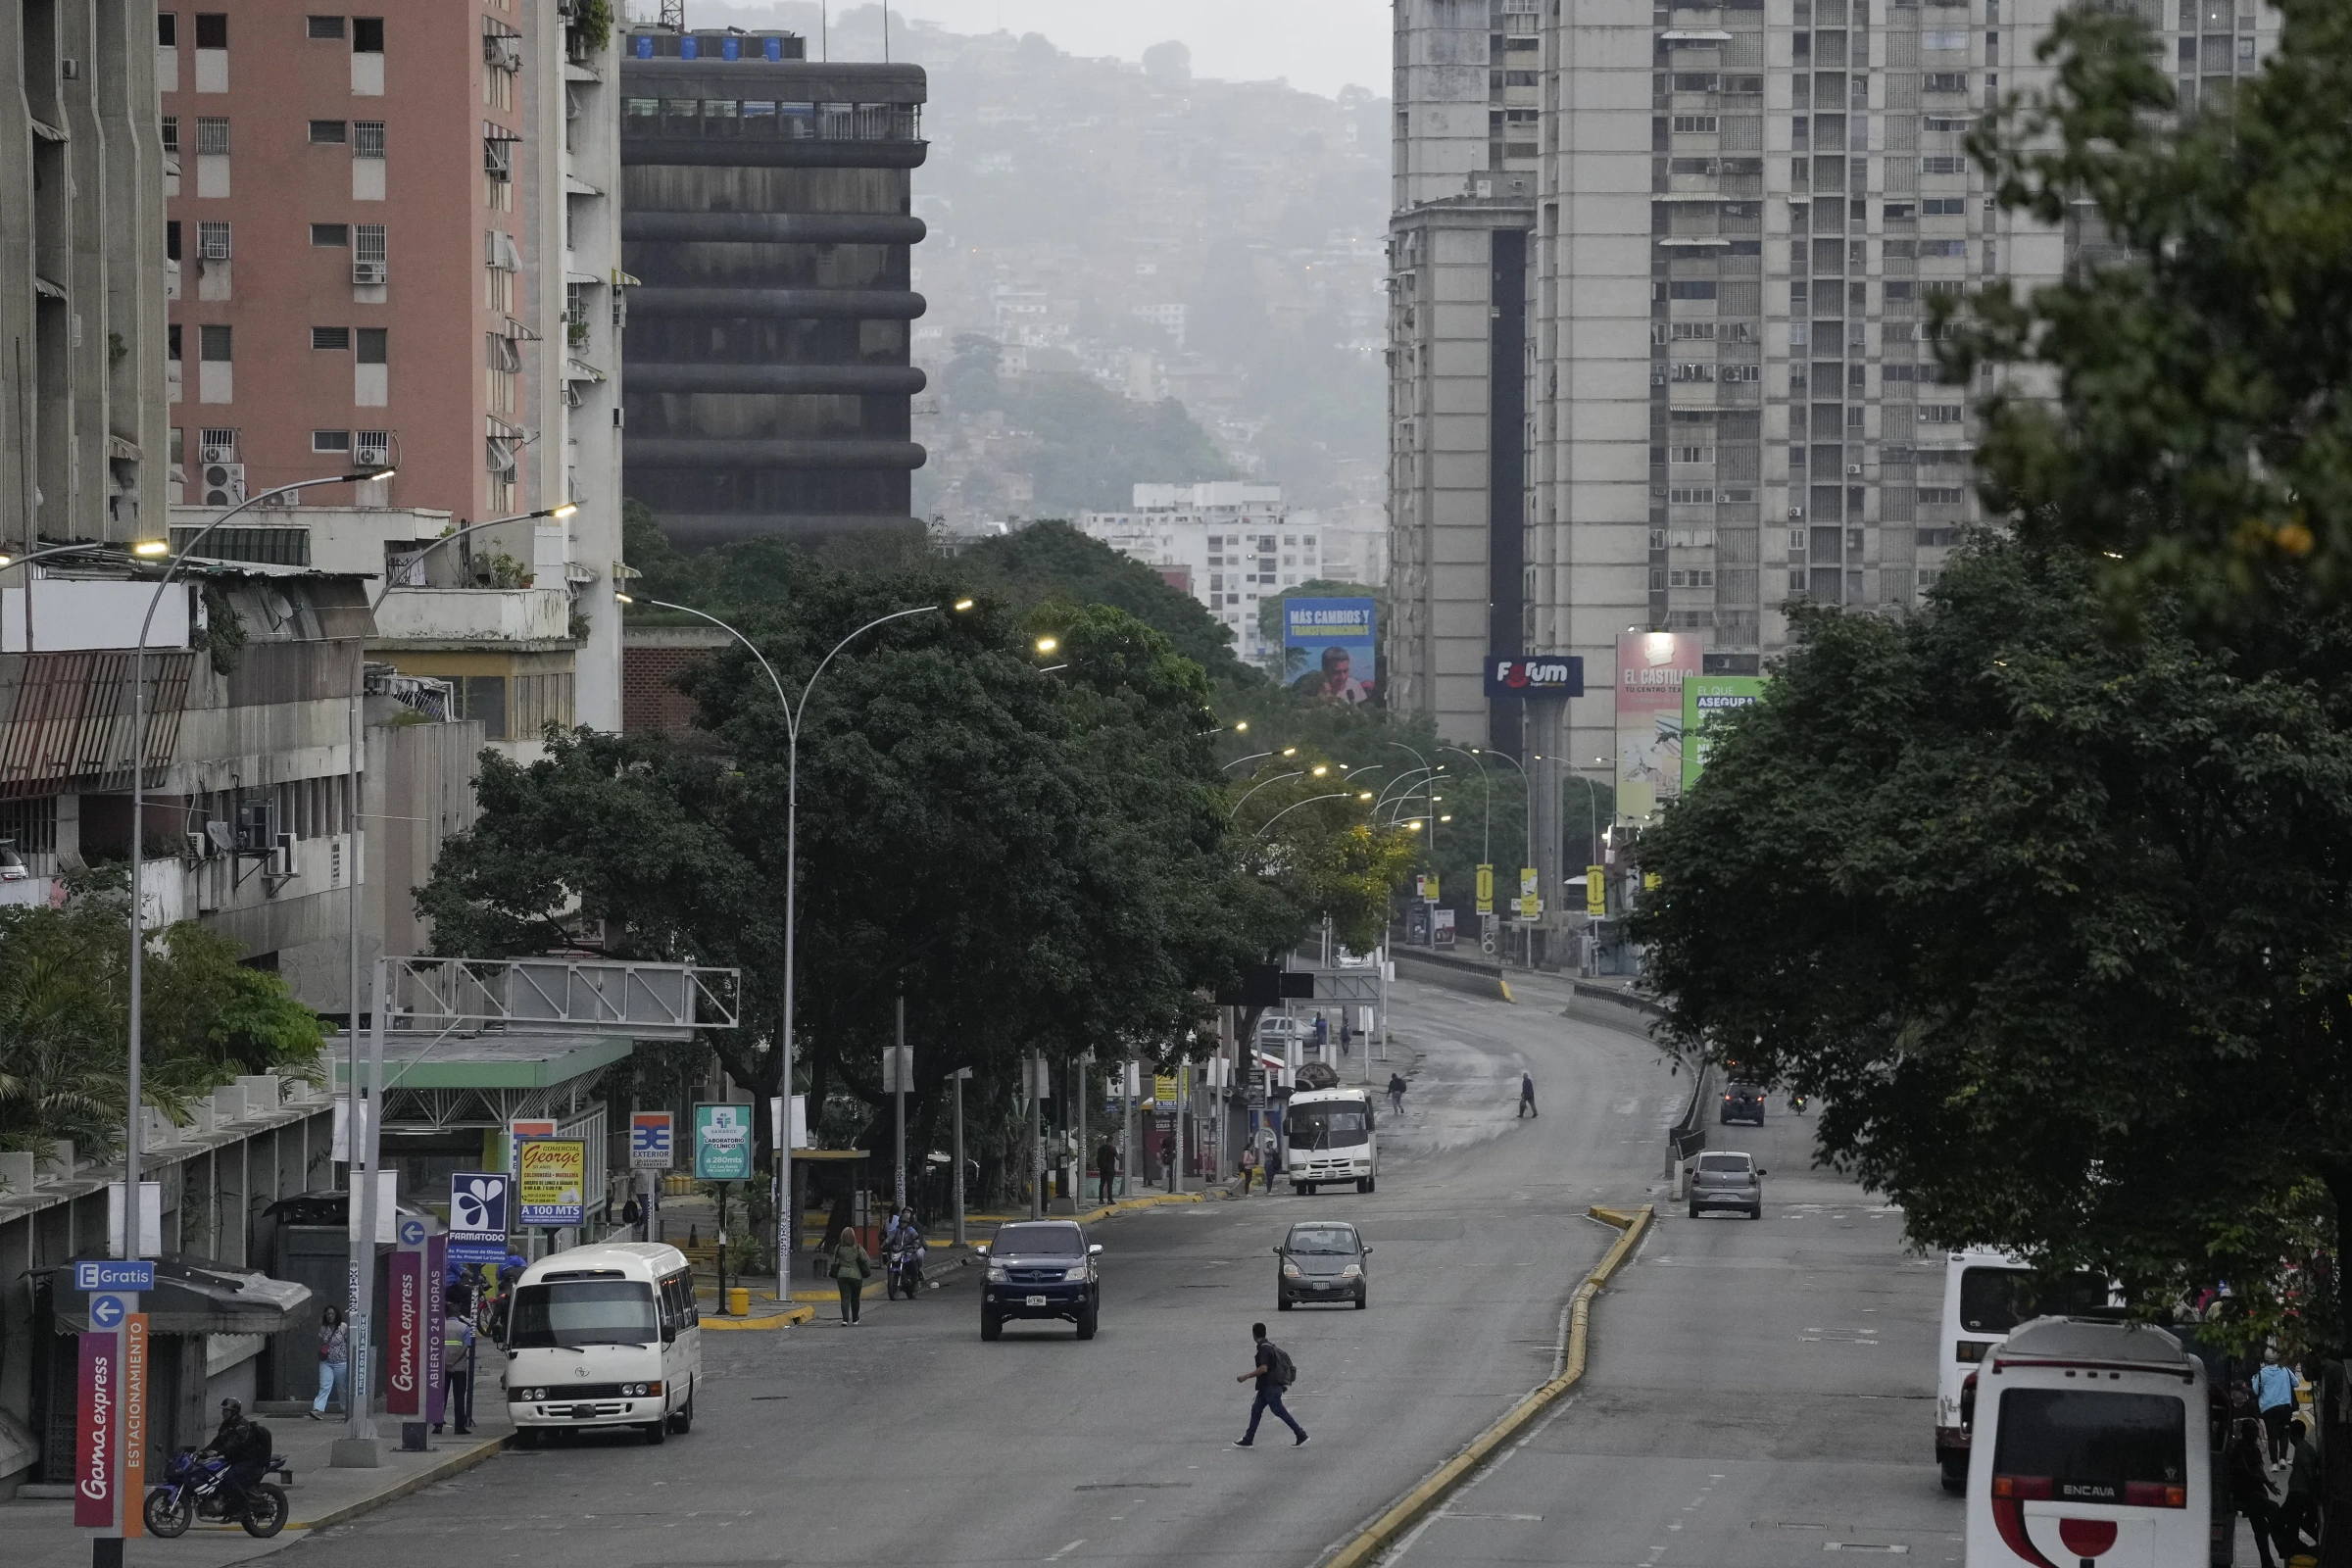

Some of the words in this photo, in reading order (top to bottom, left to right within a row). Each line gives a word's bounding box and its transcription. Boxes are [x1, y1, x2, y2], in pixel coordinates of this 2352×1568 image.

[1290, 609, 1313, 624] MÁS
[1314, 610, 1361, 624] CAMBIOS
[1624, 668, 1638, 685] EL
[1697, 686, 1709, 695] EL
[1712, 685, 1734, 696] QUE
[523, 1144, 580, 1169] George
[520, 1205, 530, 1215] A
[532, 1205, 553, 1215] 100
[555, 1205, 580, 1215] MTS
[449, 1232, 506, 1242] FARMATODO
[100, 1268, 149, 1284] Gratis
[431, 1270, 441, 1312] HORAS
[430, 1316, 440, 1333] 24
[429, 1334, 439, 1389] ABIERTO
[127, 1322, 142, 1468] ESTACIONAMIENTO
[2062, 1484, 2115, 1497] ENCAVA
